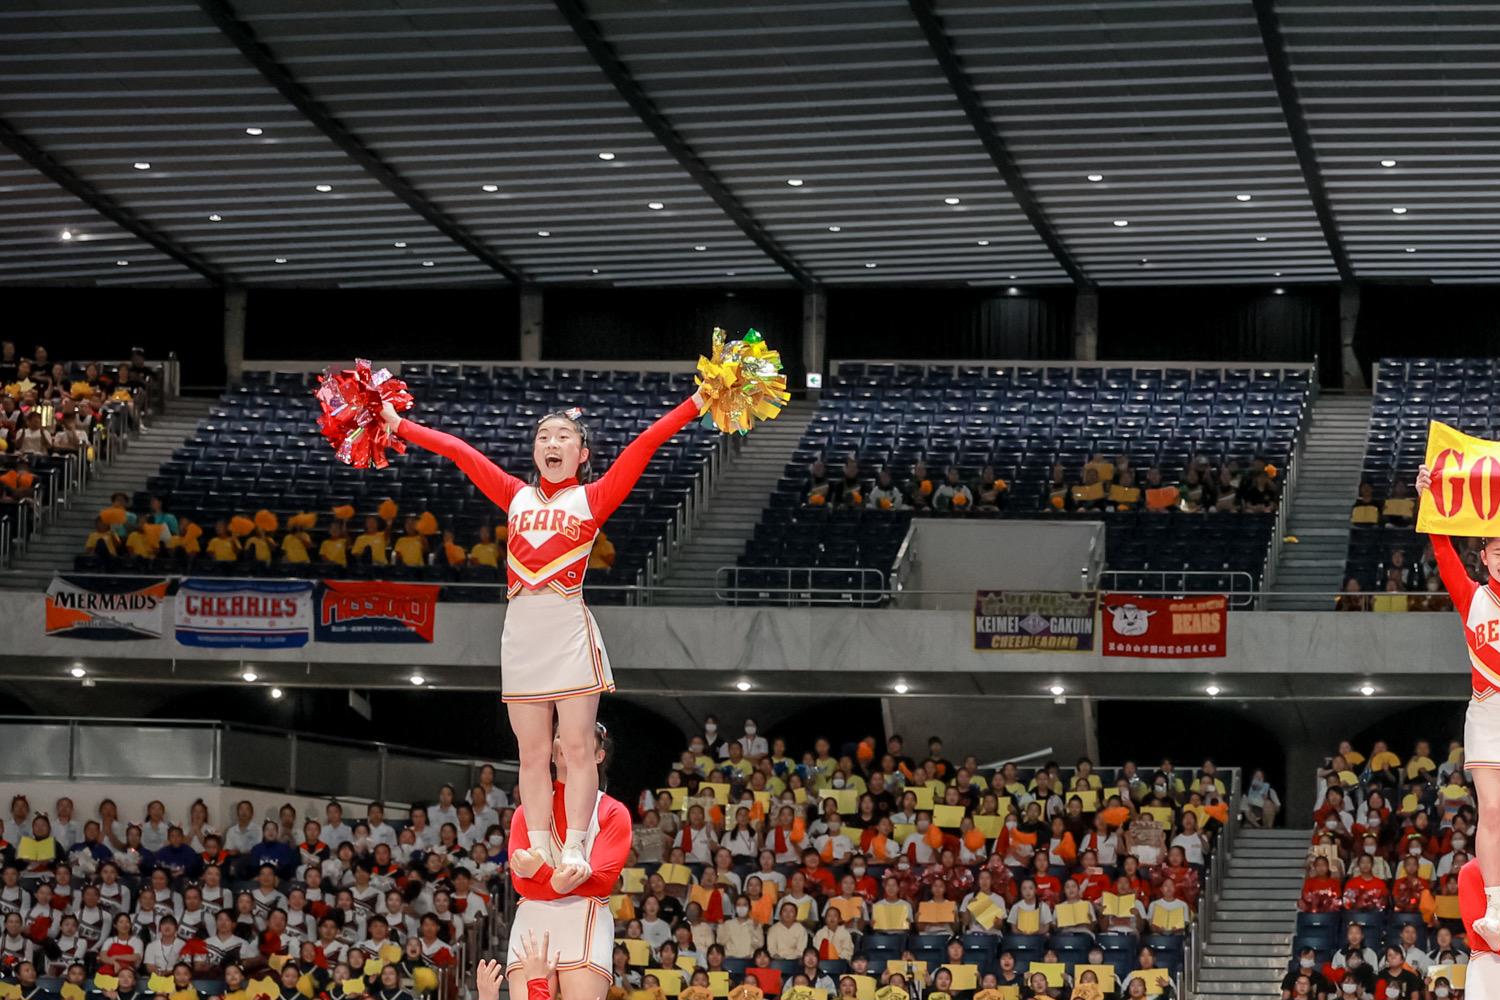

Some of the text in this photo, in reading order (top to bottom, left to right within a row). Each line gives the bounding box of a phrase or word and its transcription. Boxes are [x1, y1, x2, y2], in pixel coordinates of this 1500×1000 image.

[508, 508, 582, 541] BEARS
[54, 591, 157, 611] MERMAIDS
[185, 595, 298, 618] CHERRIES
[976, 616, 1093, 634] KEIMEI GAKUIN
[1172, 612, 1221, 635] BEARS
[991, 635, 1079, 649] CHEERLEADING
